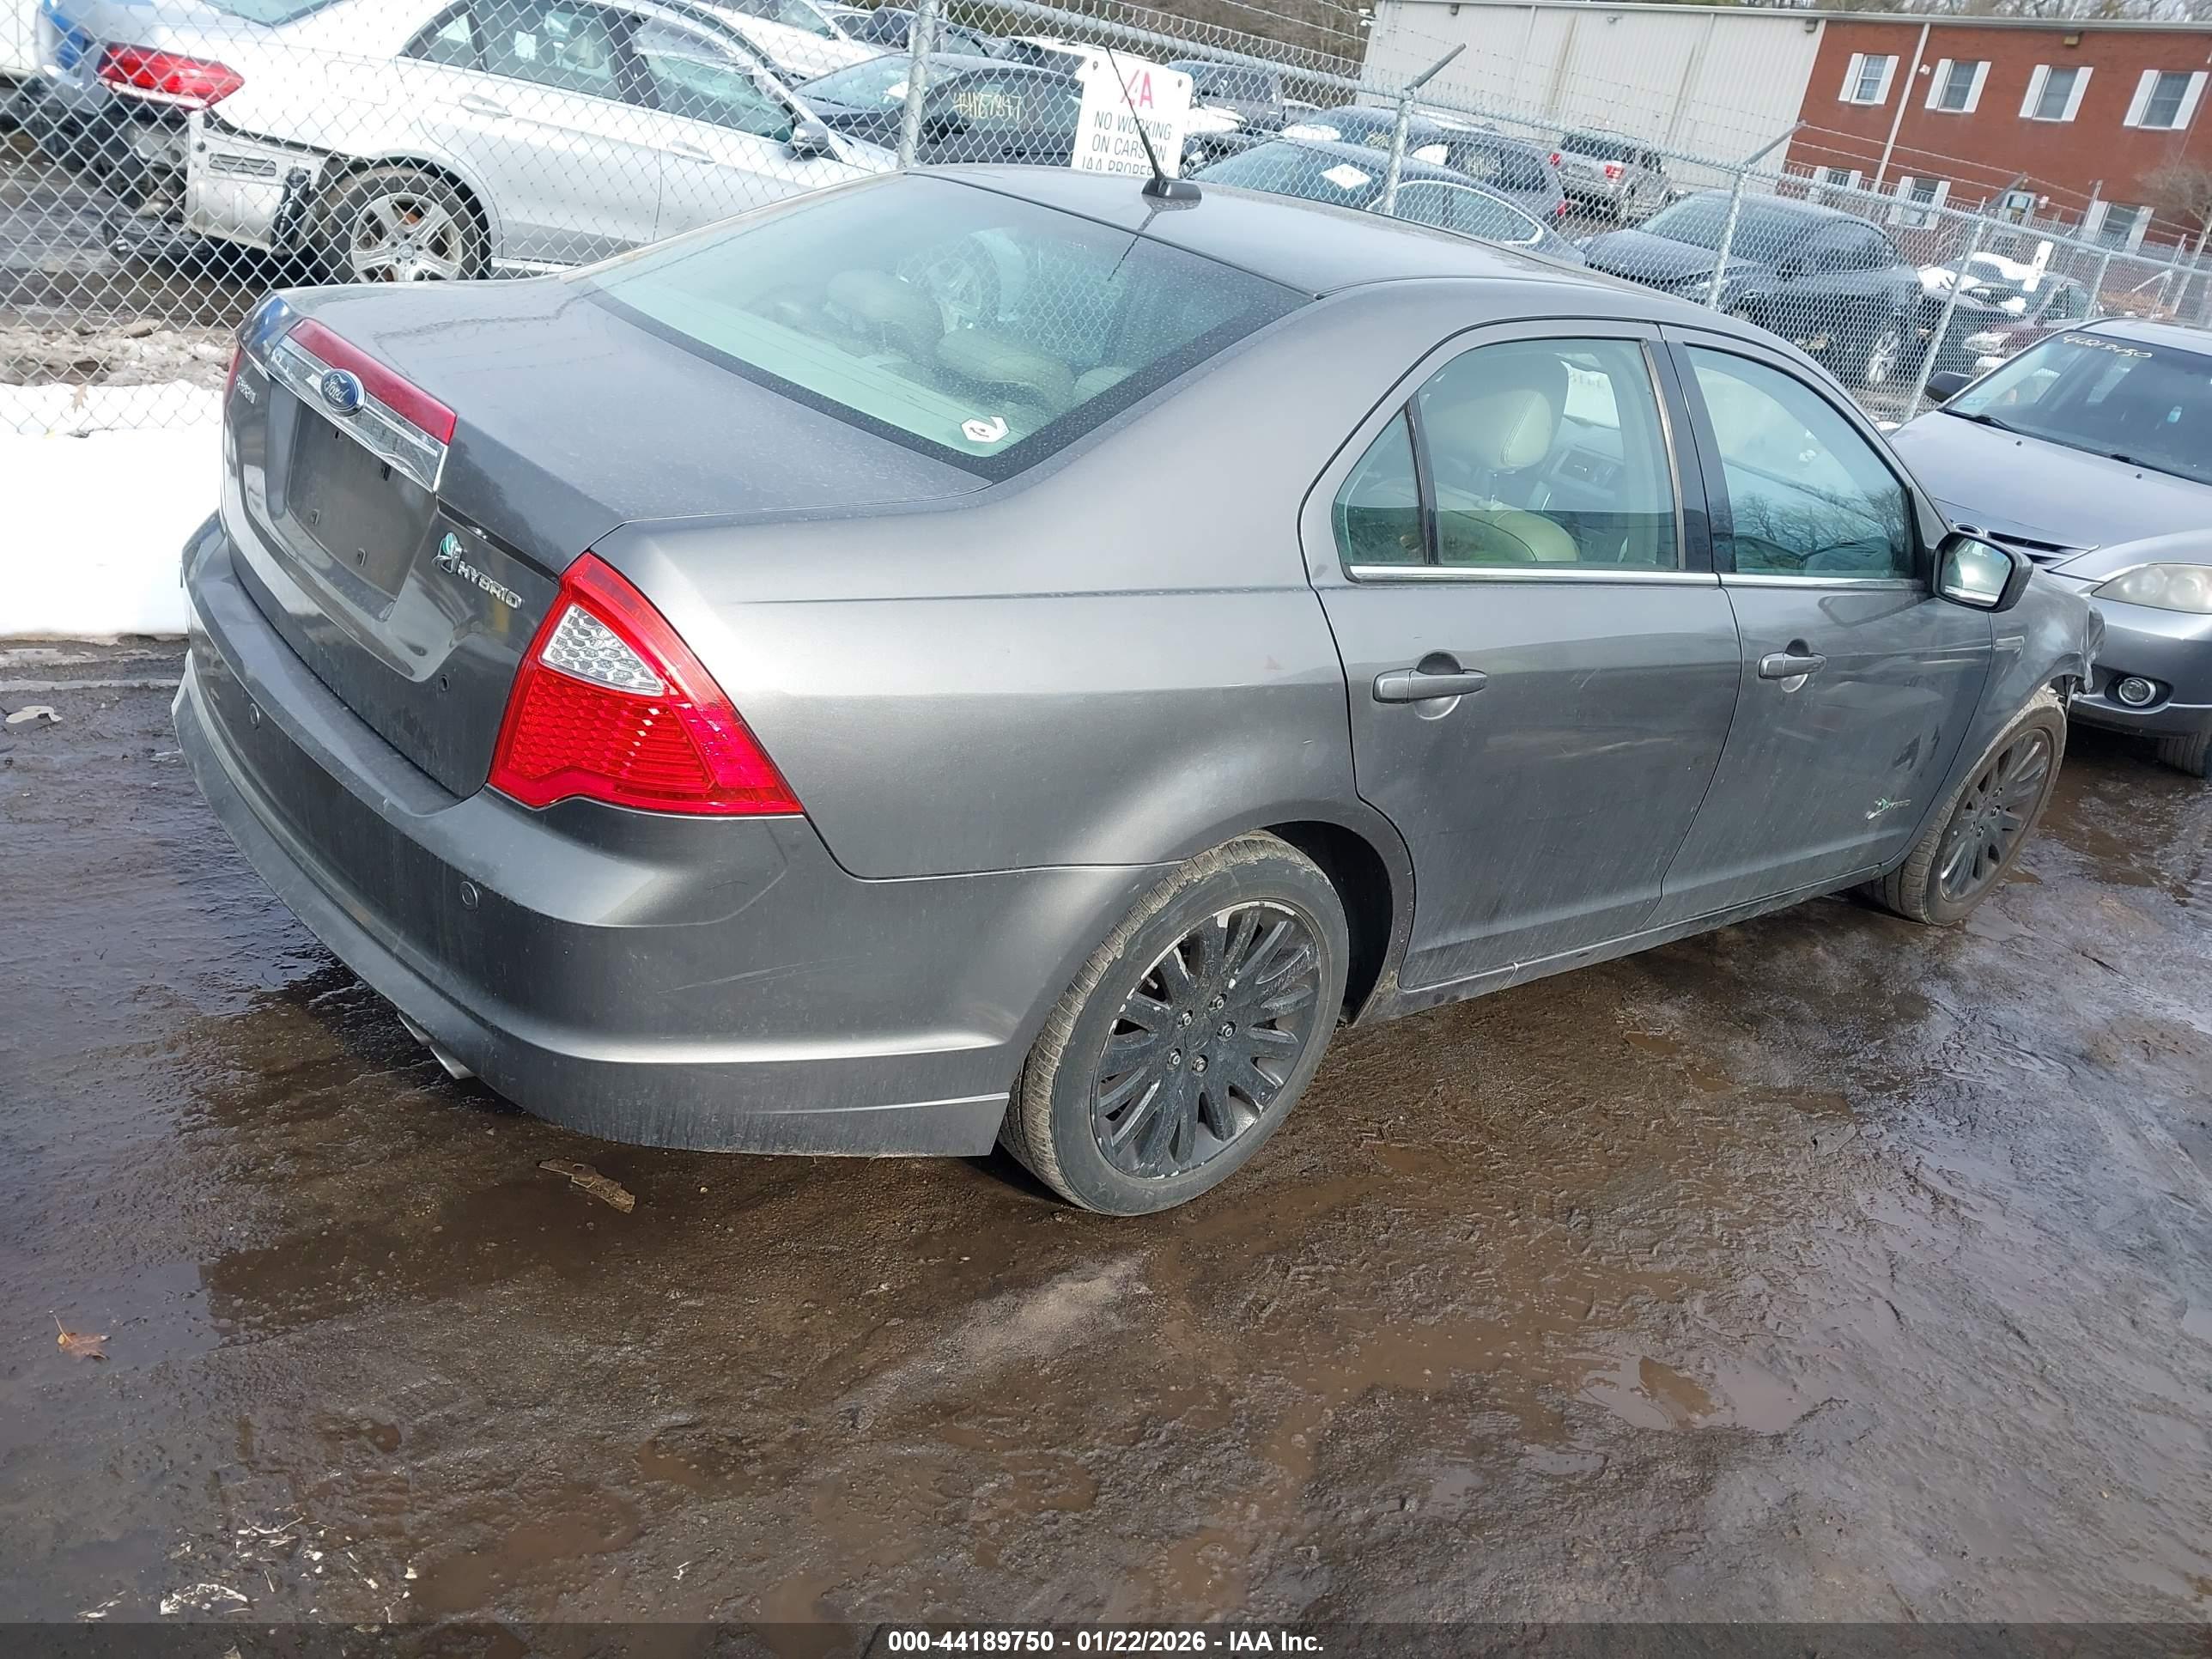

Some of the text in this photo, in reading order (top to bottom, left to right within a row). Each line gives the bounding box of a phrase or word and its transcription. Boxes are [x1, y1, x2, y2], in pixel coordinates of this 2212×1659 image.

[1094, 111, 1172, 141] NO WORKING
[1091, 133, 1110, 154] ON
[1114, 137, 1146, 159] CARS
[324, 373, 350, 403] Ford
[457, 560, 522, 610] HYBRID
